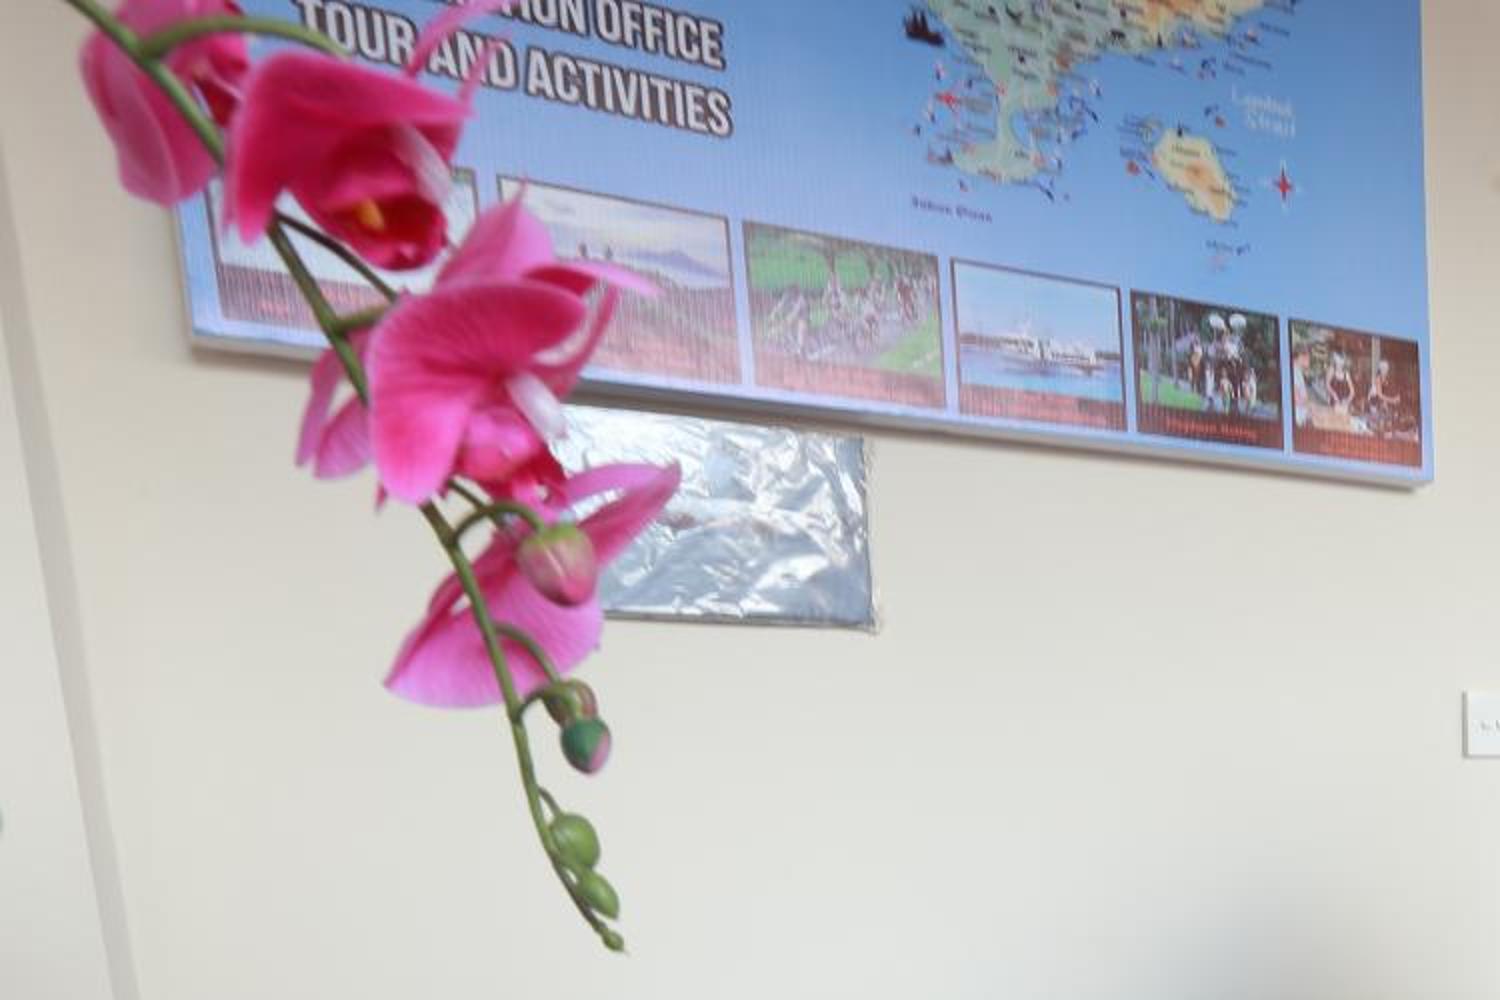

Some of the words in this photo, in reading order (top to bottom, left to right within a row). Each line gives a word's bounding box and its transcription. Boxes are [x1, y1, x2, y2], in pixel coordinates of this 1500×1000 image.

[295, 0, 416, 66] TOUR
[427, 30, 518, 89] AND
[525, 45, 733, 136] ACTIVITIES
[596, 0, 726, 69] OFFICE
